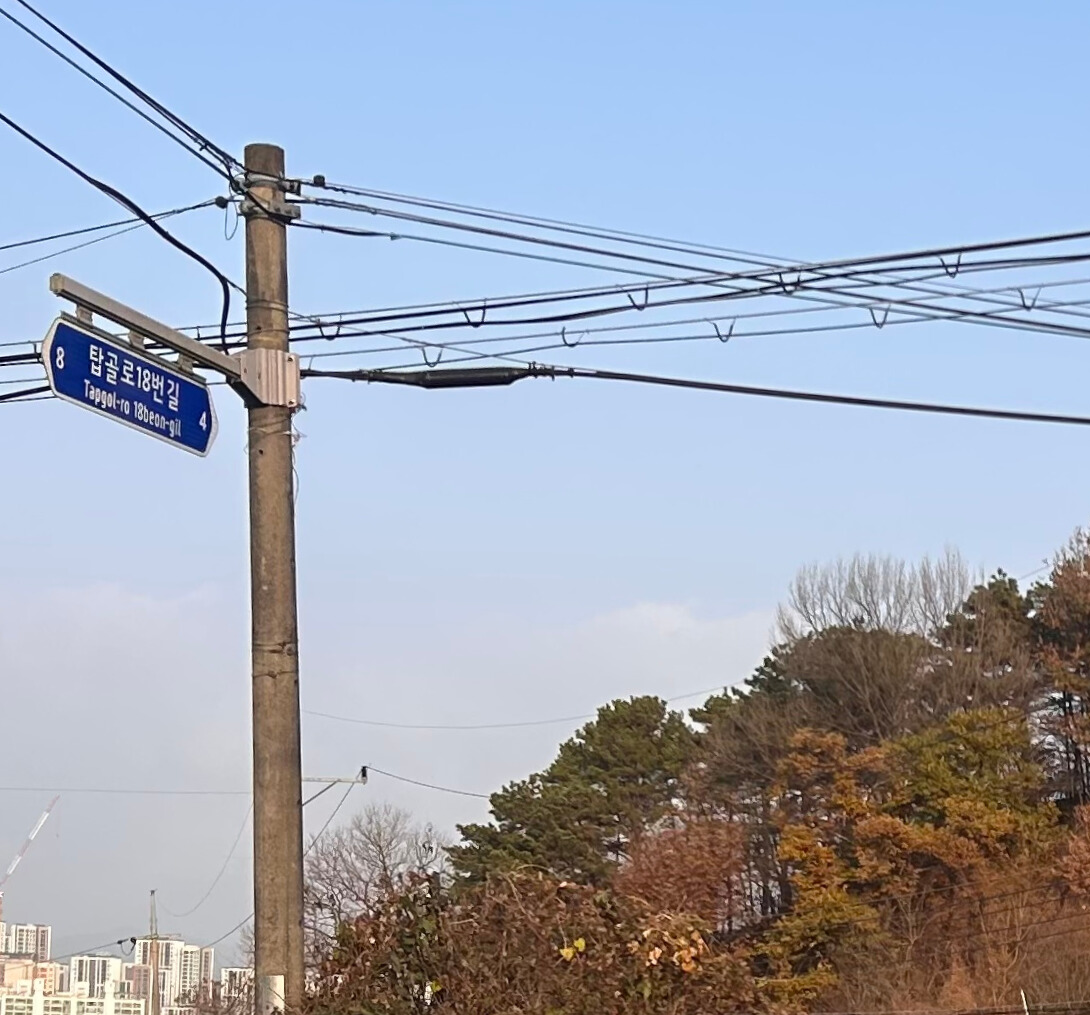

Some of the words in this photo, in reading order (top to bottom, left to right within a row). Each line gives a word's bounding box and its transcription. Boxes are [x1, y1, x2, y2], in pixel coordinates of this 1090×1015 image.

[55, 346, 65, 370] 8
[89, 343, 180, 412] 탑골로18번길
[83, 378, 130, 415] Tapgol-ro
[133, 400, 182, 438] 18beon-gil
[199, 411, 208, 431] 4
